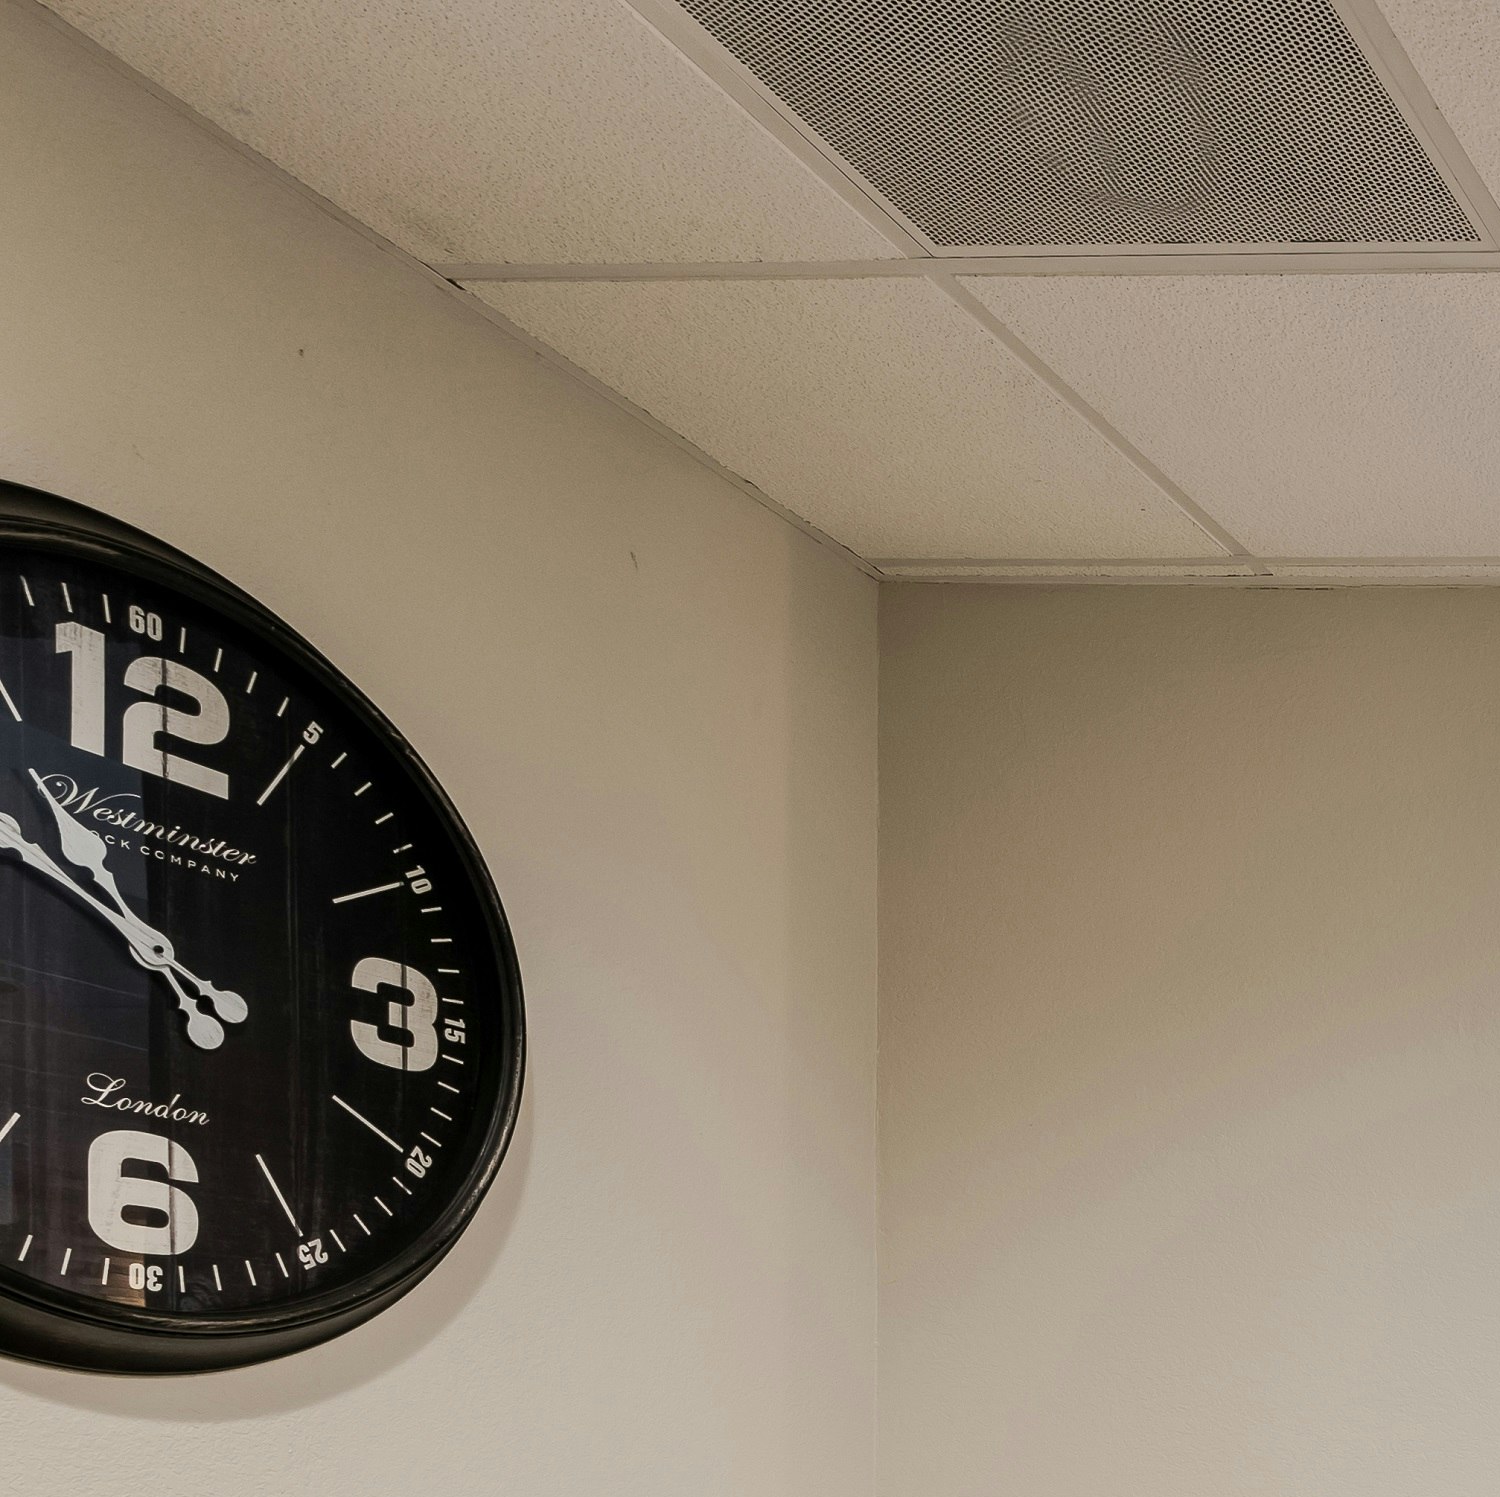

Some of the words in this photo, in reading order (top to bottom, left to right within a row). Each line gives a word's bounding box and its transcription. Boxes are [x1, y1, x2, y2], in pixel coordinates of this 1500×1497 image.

[129, 605, 163, 642] 60
[55, 620, 230, 801] 12
[303, 720, 324, 745] 5
[37, 773, 258, 866] Westminster
[139, 844, 240, 883] COMPANY
[404, 864, 433, 895] 10
[350, 956, 439, 1072] 3
[443, 1017, 466, 1046] 15
[81, 1072, 211, 1126] London
[405, 1145, 433, 1179] 20
[87, 1129, 200, 1256] 6
[295, 1238, 329, 1271] 25
[128, 1262, 164, 1292] 30
